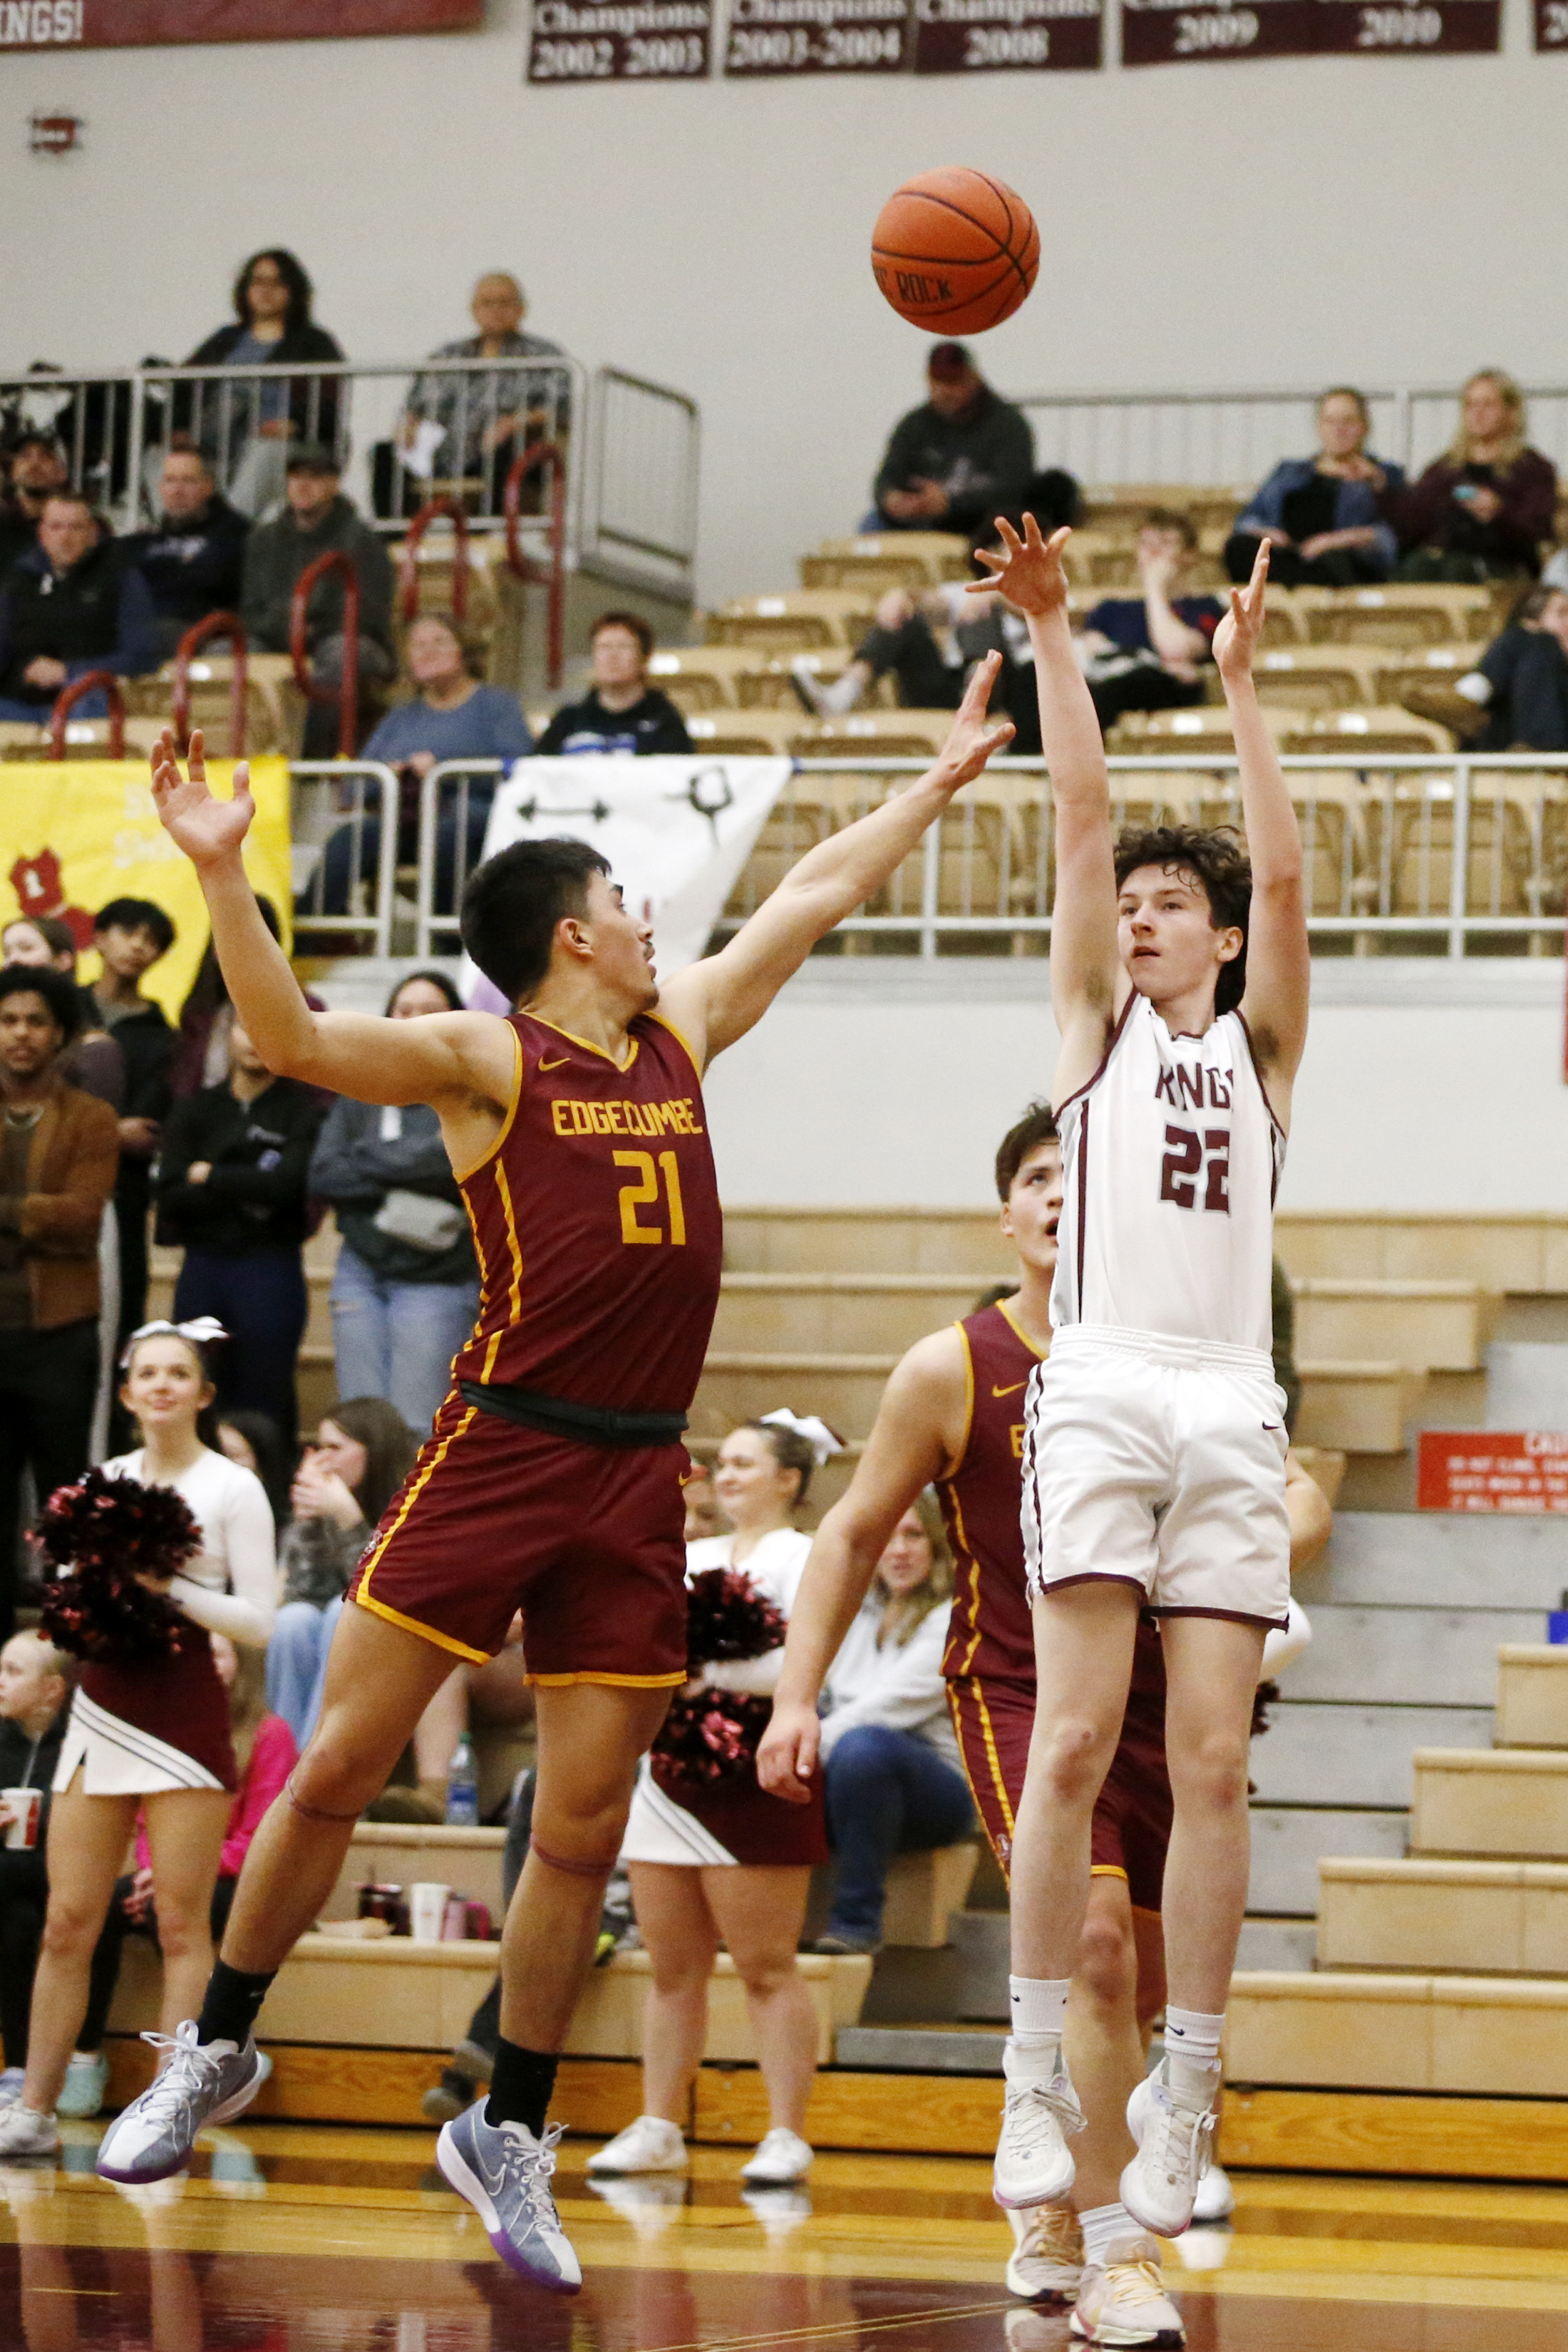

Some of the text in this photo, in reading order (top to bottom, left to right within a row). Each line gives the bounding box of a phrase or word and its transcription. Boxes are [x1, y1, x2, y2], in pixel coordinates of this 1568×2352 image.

[534, 1, 710, 36] Champions
[551, 1098, 703, 1136] EDGECUMBE
[612, 1149, 686, 1246] 21
[1158, 1120, 1232, 1217] 22
